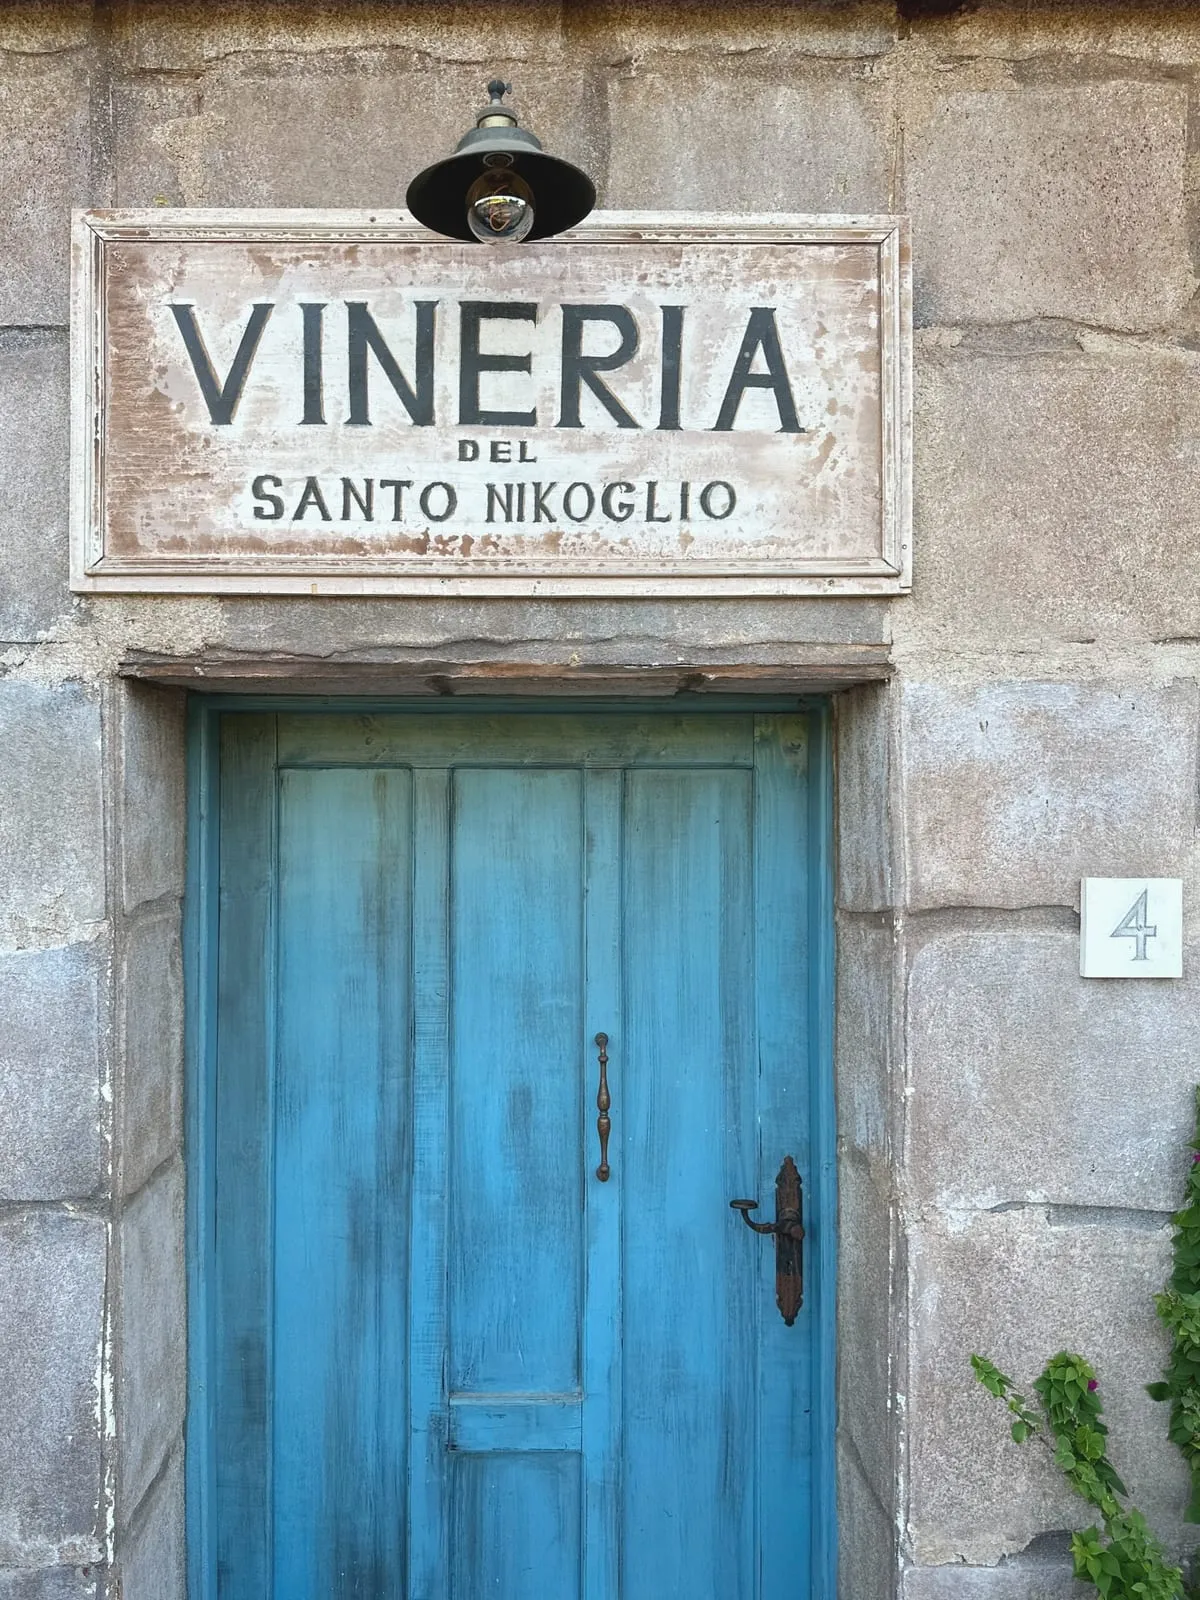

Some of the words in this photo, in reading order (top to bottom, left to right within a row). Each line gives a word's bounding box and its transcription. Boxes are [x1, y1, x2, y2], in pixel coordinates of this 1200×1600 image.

[169, 300, 807, 433] VINERIA
[457, 439, 537, 463] DEL
[252, 474, 459, 523] SANTO
[484, 479, 738, 523] NIKOGLIO
[1110, 888, 1157, 961] 4
